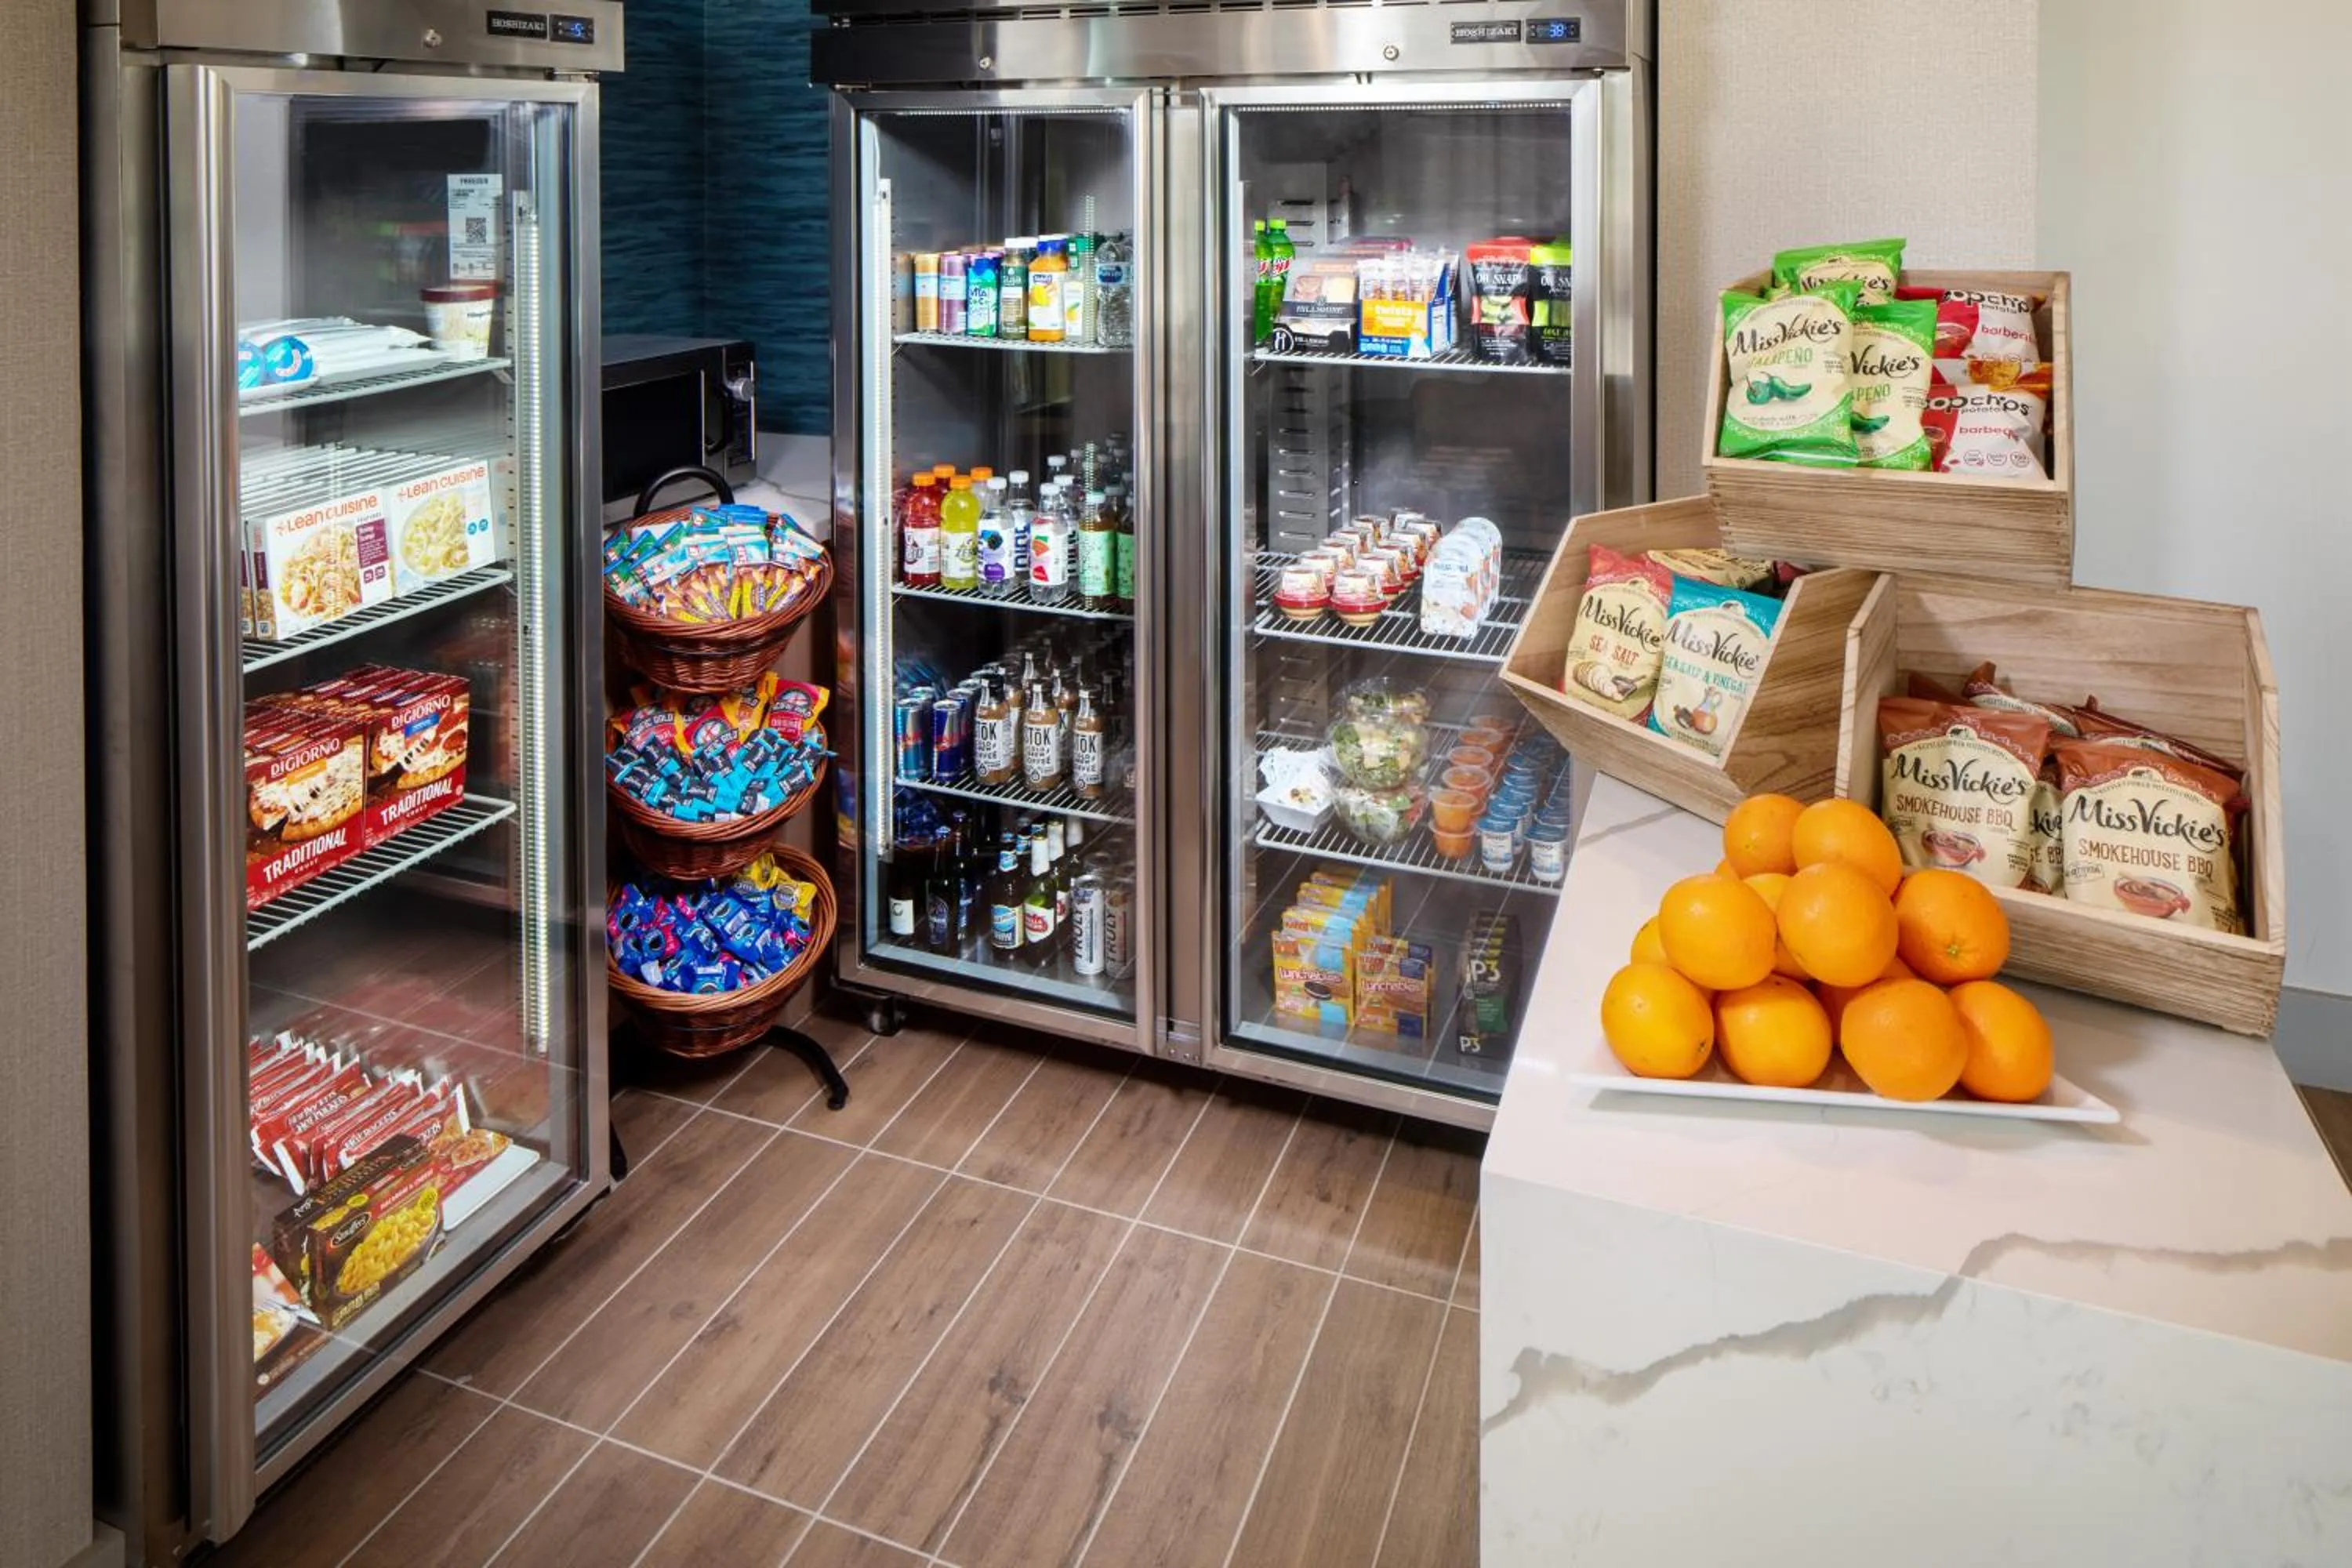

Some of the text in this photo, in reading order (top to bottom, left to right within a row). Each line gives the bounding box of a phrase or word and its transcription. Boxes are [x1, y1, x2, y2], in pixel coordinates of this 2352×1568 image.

[491, 18, 546, 31] HOSHIZAKI
[1454, 27, 1519, 38] HOSHIZAKI
[1732, 313, 1842, 357] Miss Vickie's
[1850, 344, 1921, 379] Vickie's
[1580, 594, 1664, 655] Miss Vickie'
[1612, 644, 1640, 666] SALT
[1711, 630, 1760, 680] Vickie'
[379, 777, 453, 826] TRADITIONAL
[1891, 753, 2028, 805] Miss Vickie's
[1896, 793, 1982, 824] SMOKEHOUSE
[1986, 808, 2017, 832] BBQ
[2067, 794, 2138, 832] Miss
[2128, 797, 2227, 854] Vickie's
[263, 827, 347, 884] TRADITIONAL
[2078, 837, 2182, 872] SMOKEHOUSE
[2187, 855, 2214, 884] BBQ
[1073, 902, 1083, 960] TRULY
[1470, 959, 1502, 982] P3
[1459, 1035, 1481, 1053] P3
